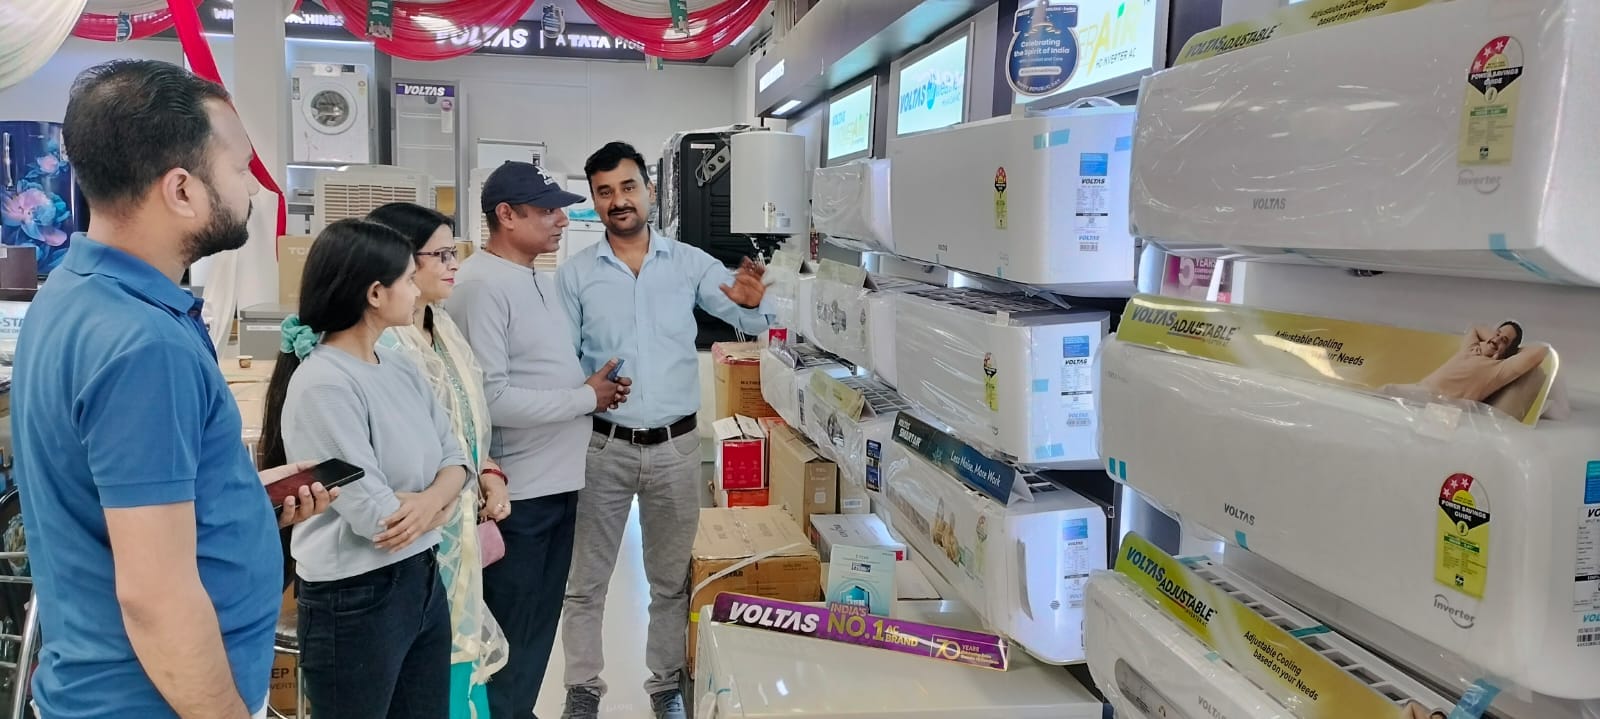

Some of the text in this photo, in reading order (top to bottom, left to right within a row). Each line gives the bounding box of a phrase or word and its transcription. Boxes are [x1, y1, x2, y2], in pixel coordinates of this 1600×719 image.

[556, 35, 566, 46] A
[568, 36, 611, 48] TATA
[1021, 38, 1061, 49] Celebrating
[1218, 25, 1276, 52] ADJUSTABLE
[1014, 50, 1024, 58] the
[1024, 48, 1042, 57] Spirit
[1051, 46, 1070, 55] India
[404, 85, 445, 96] VOLTAS
[900, 84, 926, 114] VOLTAS
[1252, 197, 1287, 210] VOLTAS
[1131, 306, 1235, 341] VOLTAS ADJUSTABLE
[1275, 330, 1344, 352] Adjustable Cooling
[1337, 352, 1365, 367] Needs
[987, 469, 1001, 487] Work
[1224, 503, 1256, 526] VOLTAS
[1441, 499, 1487, 519] POWER SAVINGS
[1454, 510, 1472, 522] GUIDE
[1126, 546, 1166, 582] VOLTAS
[1158, 577, 1214, 622] ADJUSTABLE
[729, 602, 821, 633] VOLTAS
[830, 602, 868, 617] INDIA'S
[886, 625, 900, 634] AC
[885, 634, 919, 648] BRAND
[936, 638, 961, 660] 70
[1244, 630, 1302, 677] Adjustable Cooling
[1253, 649, 1319, 702] based on your Needs
